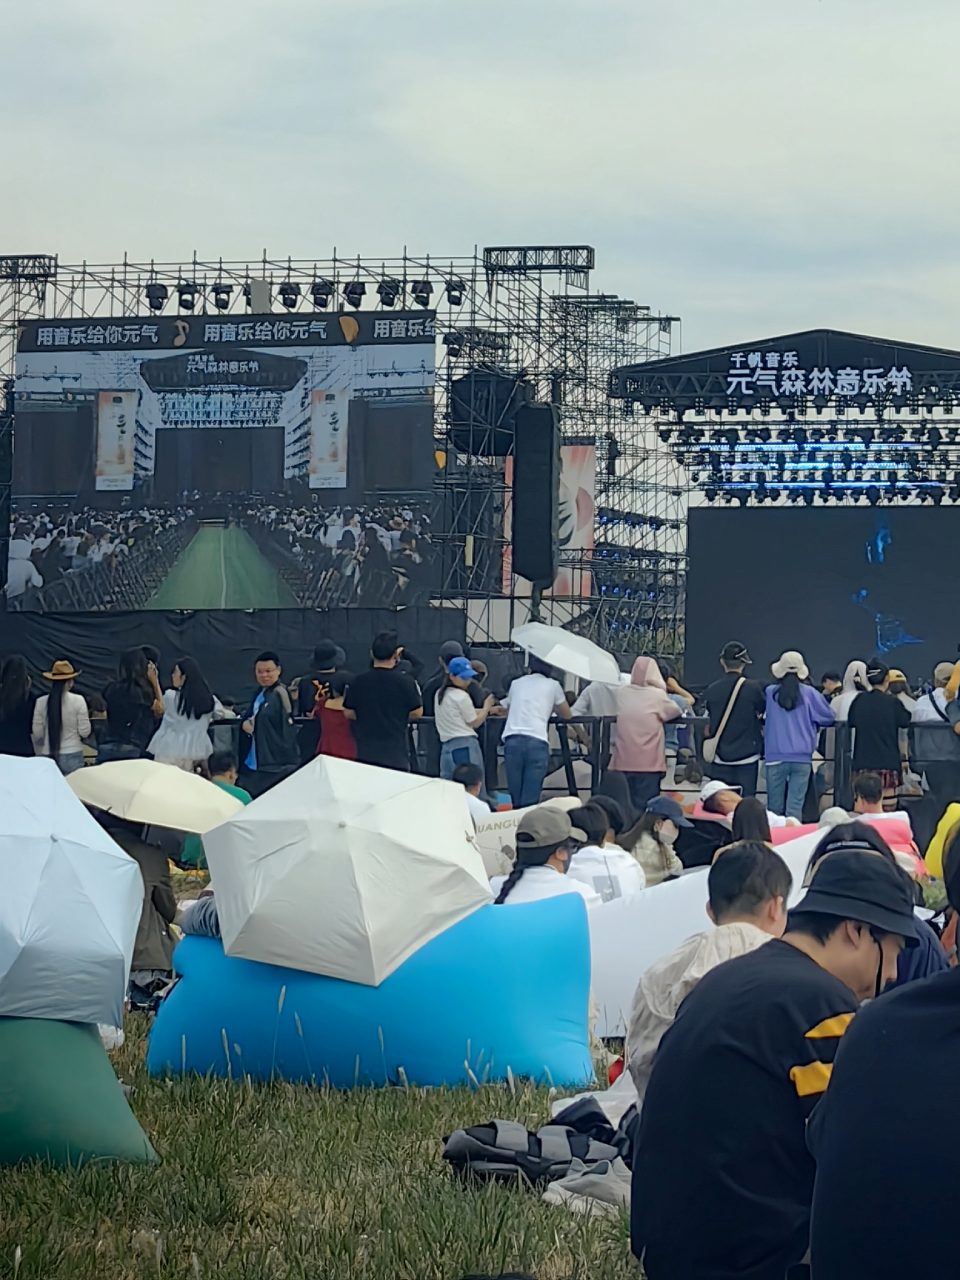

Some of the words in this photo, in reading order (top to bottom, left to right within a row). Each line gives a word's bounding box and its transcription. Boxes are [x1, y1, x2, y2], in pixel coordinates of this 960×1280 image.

[37, 325, 159, 346] 用音乐给你元气
[204, 321, 328, 342] 用音乐给你元气
[731, 351, 798, 368] 千帆音乐
[727, 367, 912, 396] 元气森林音乐节
